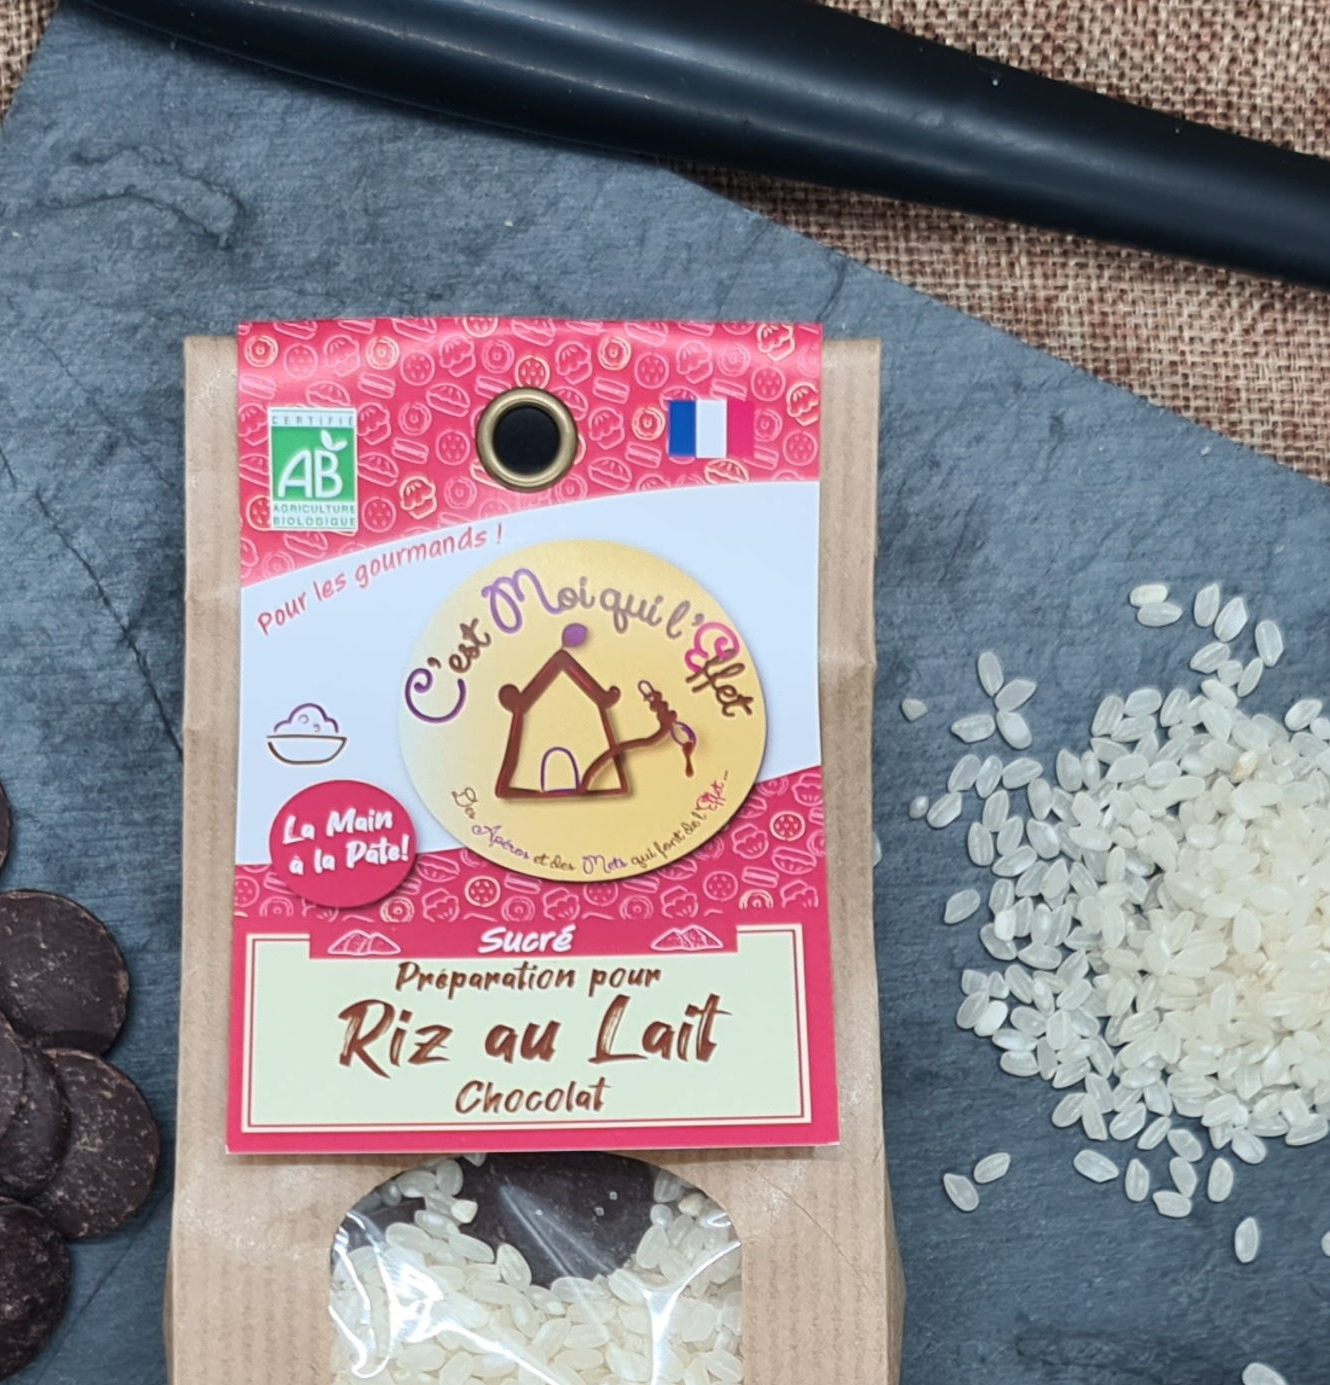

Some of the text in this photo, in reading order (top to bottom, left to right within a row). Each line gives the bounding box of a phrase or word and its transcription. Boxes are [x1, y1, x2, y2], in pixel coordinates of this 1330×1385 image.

[277, 449, 344, 498] AB
[273, 504, 355, 514] AGRICULTURE
[273, 516, 355, 526] BIOLOGIQUE
[257, 522, 503, 635] Pour les gourmands !
[404, 617, 491, 724] C'est
[481, 567, 595, 634] Moi
[599, 587, 664, 634] qui
[282, 806, 394, 845] La Main
[289, 854, 305, 876] à
[313, 847, 336, 874] la
[533, 853, 550, 866] et
[550, 854, 575, 871] des
[582, 854, 628, 875] Mets
[631, 848, 657, 869] qui
[653, 831, 686, 859] font
[681, 821, 701, 836] de
[477, 924, 577, 954] Sucré
[394, 960, 662, 1000] Préparation pour
[337, 992, 733, 1079] Riz au Lait
[454, 1076, 612, 1115] Chocolat
